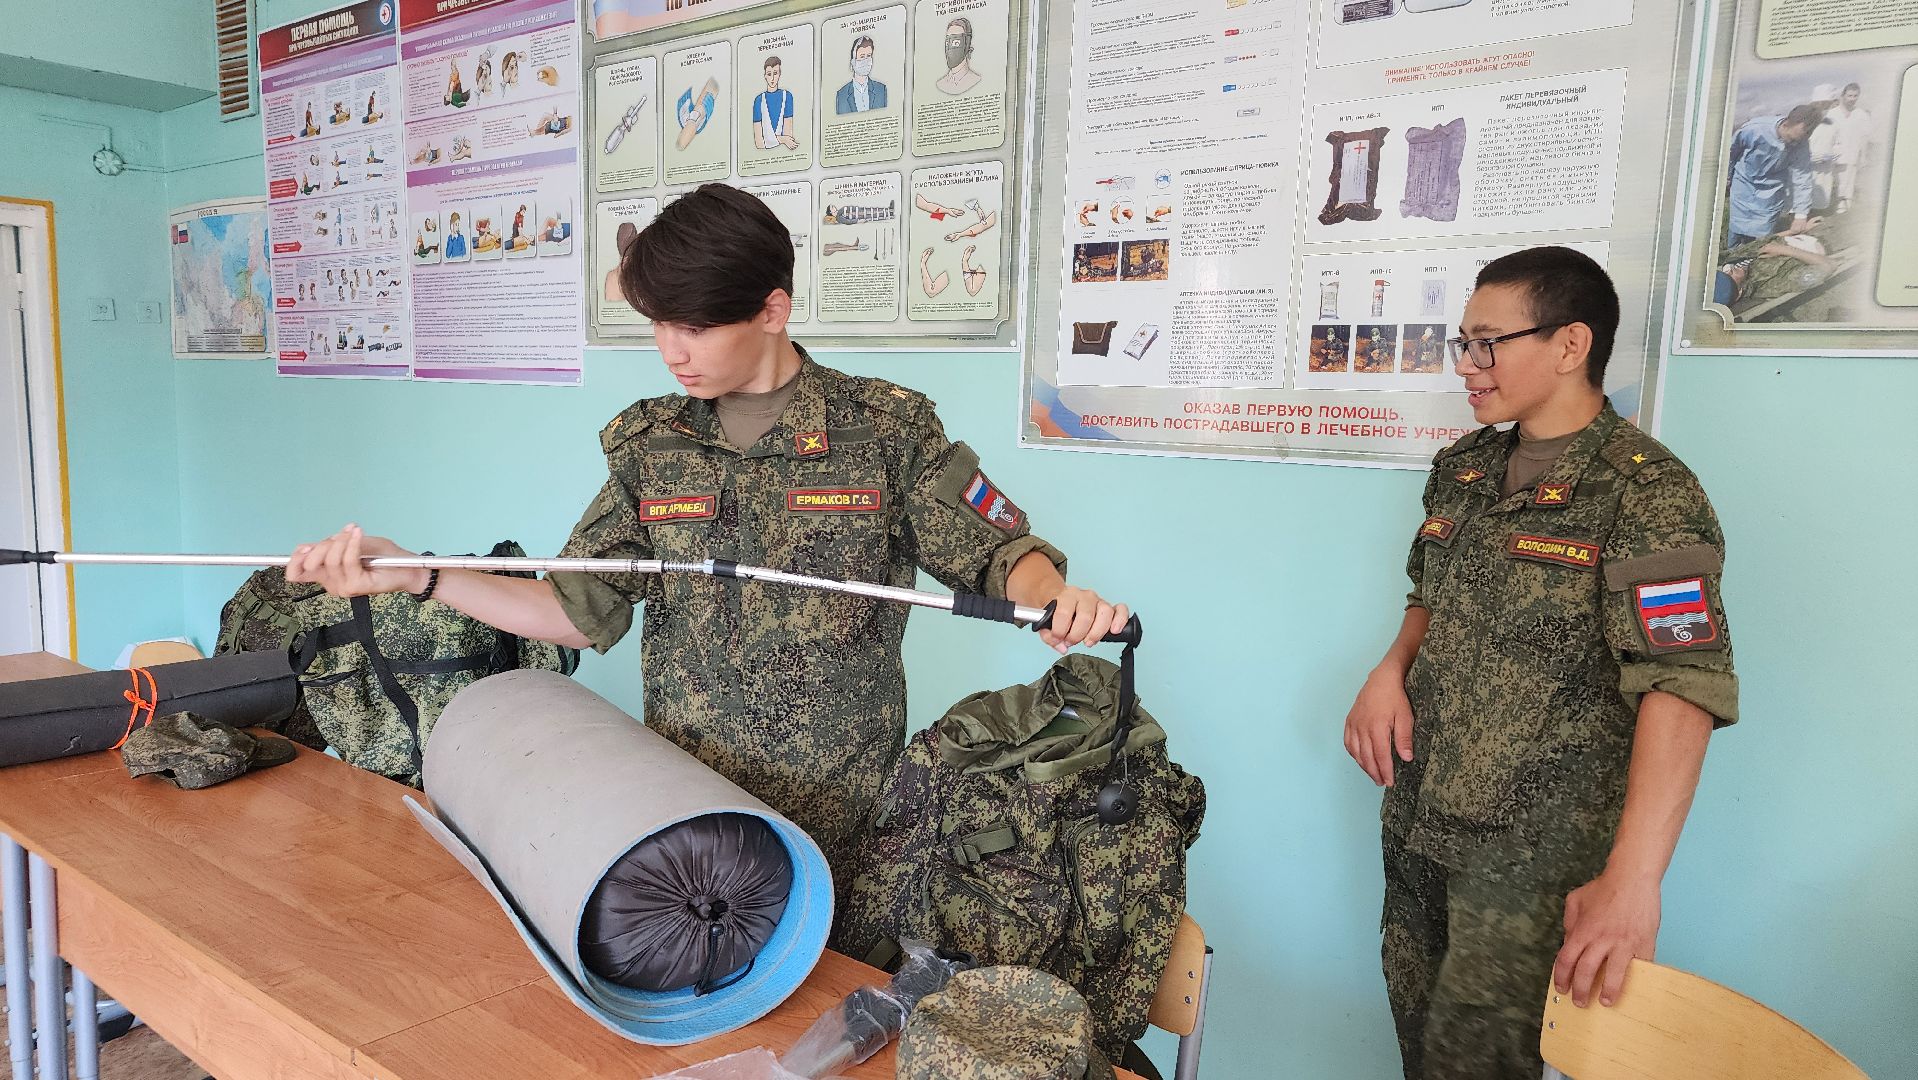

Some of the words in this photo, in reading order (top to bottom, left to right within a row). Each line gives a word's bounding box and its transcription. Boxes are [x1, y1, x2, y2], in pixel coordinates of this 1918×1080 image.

[291, 21, 318, 42] ПЕРВАЯ
[319, 11, 355, 33] ПОМОЩЬ
[1502, 50, 1536, 61] ОПАСНО!
[1429, 69, 1457, 79] ТОЛЬКО
[1465, 63, 1499, 74] КРАЙНЕМ
[1500, 59, 1531, 70] СЛУЧАЕ!
[1500, 93, 1523, 102] ПАКЕТ
[1524, 85, 1587, 99] ПЕРЕВЯЗОЧНЫЙ
[1184, 402, 1241, 415] ОКАЗАВ
[1247, 403, 1312, 418] ПЕРВУЮ
[1319, 405, 1404, 422] ПОМОЩЬ,
[1080, 414, 1159, 429] ДОСТАВИТЬ
[1163, 418, 1294, 434] ПОСТРАДАВШЕГО
[1301, 422, 1311, 435] В
[1317, 423, 1408, 439] ЛЕЧЕБНОЕ
[649, 505, 667, 516] ВПК
[667, 502, 706, 515] АРМЕЕЦ
[796, 495, 850, 505] ЕРМАКОВ
[852, 494, 872, 505] Г.С.
[1516, 539, 1566, 555] ВОЛОДИН
[1566, 546, 1590, 562] В.Д.
